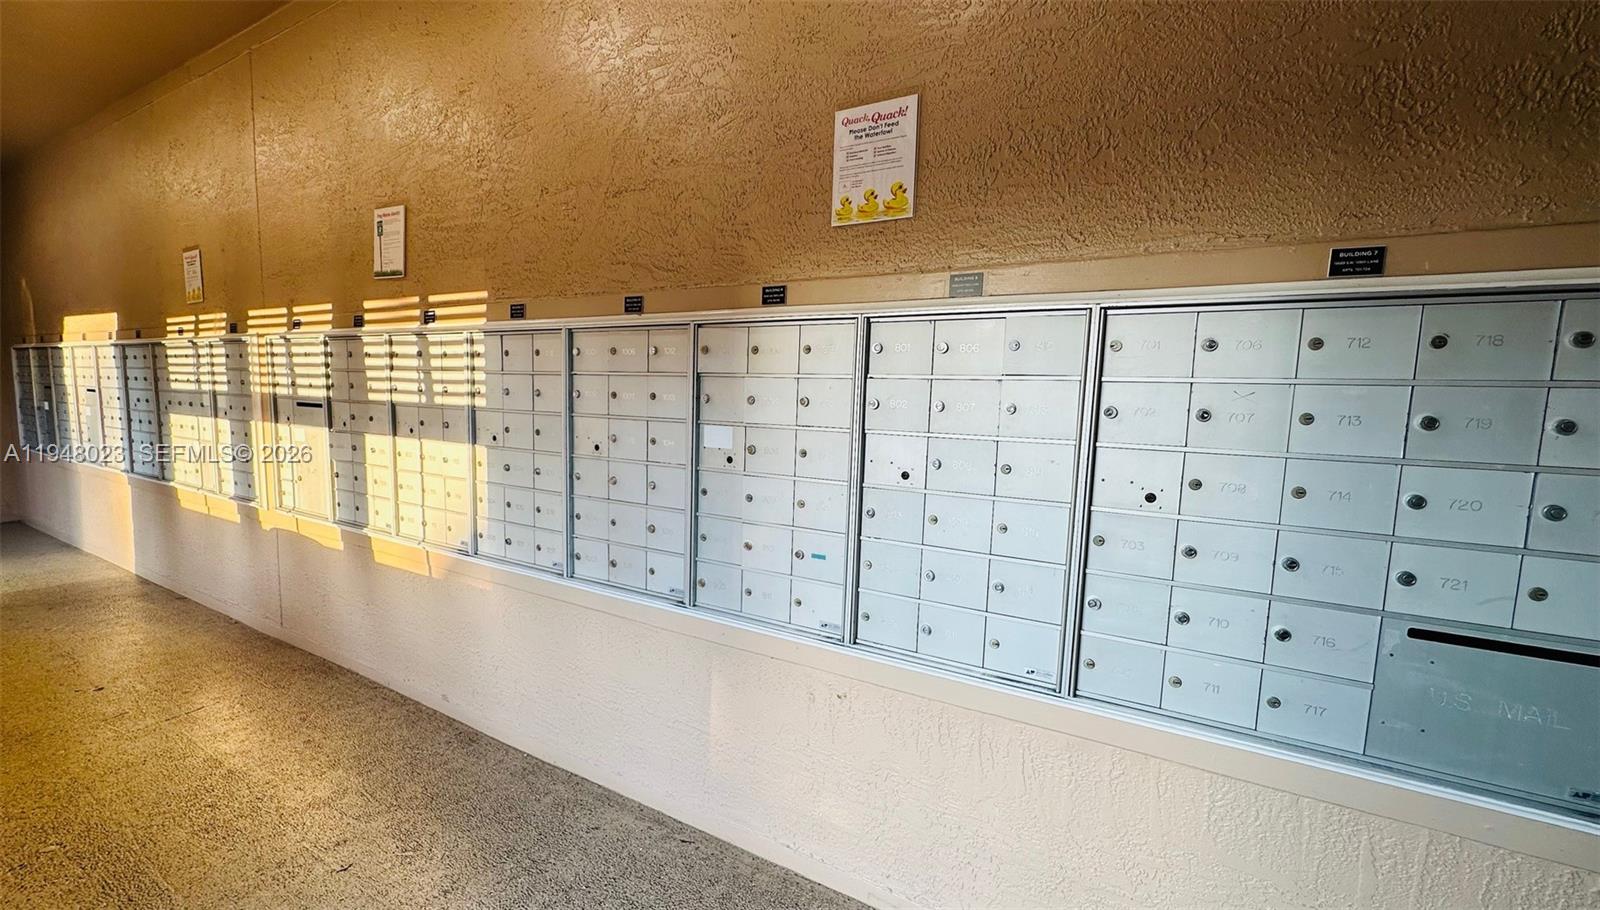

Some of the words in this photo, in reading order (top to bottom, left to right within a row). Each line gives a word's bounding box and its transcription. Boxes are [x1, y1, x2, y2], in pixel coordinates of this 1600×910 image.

[871, 105, 908, 124] Quack!
[884, 120, 899, 128] Feed
[1235, 339, 1263, 351] 706
[1347, 336, 1372, 349] 712
[1476, 334, 1505, 348] 718
[1227, 412, 1256, 424] 707
[1336, 414, 1363, 427] 713
[1463, 416, 1493, 430] 719
[1327, 489, 1353, 503] 714
[1448, 499, 1484, 512] 720
[1120, 538, 1145, 551] 703
[1211, 549, 1240, 562] 709
[1320, 562, 1344, 577] 715
[1439, 576, 1470, 592] 721
[1207, 616, 1231, 630] 710
[1311, 634, 1336, 648] 716
[1202, 682, 1222, 695] 711
[1303, 703, 1328, 718] 717
[1499, 700, 1573, 731] MAIL
